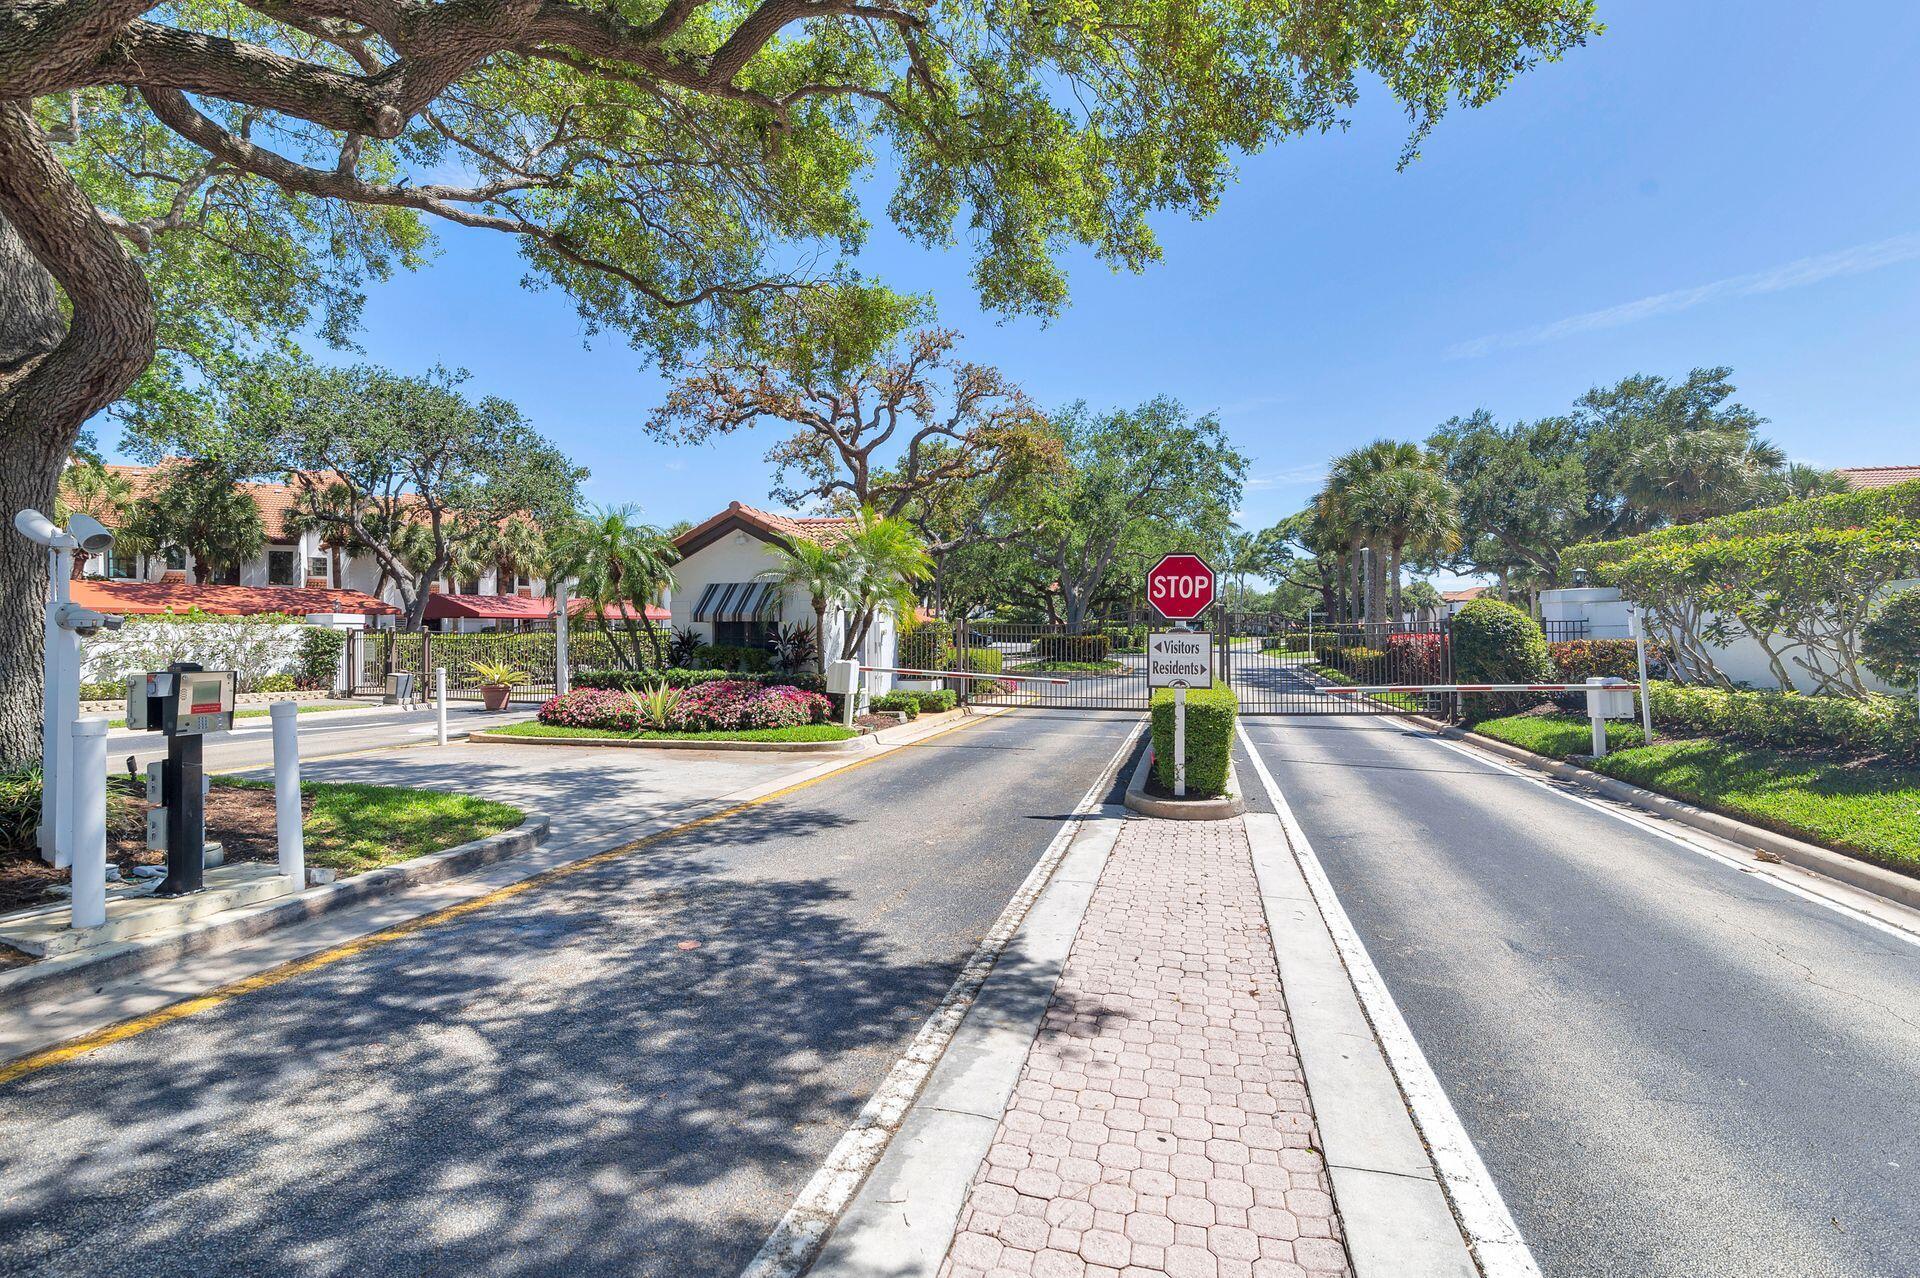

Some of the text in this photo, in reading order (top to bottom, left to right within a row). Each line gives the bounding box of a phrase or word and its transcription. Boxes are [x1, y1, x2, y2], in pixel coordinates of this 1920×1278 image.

[1153, 576, 1209, 598] STOP
[1164, 641, 1200, 654] Visitors
[1153, 661, 1199, 675] Residents
